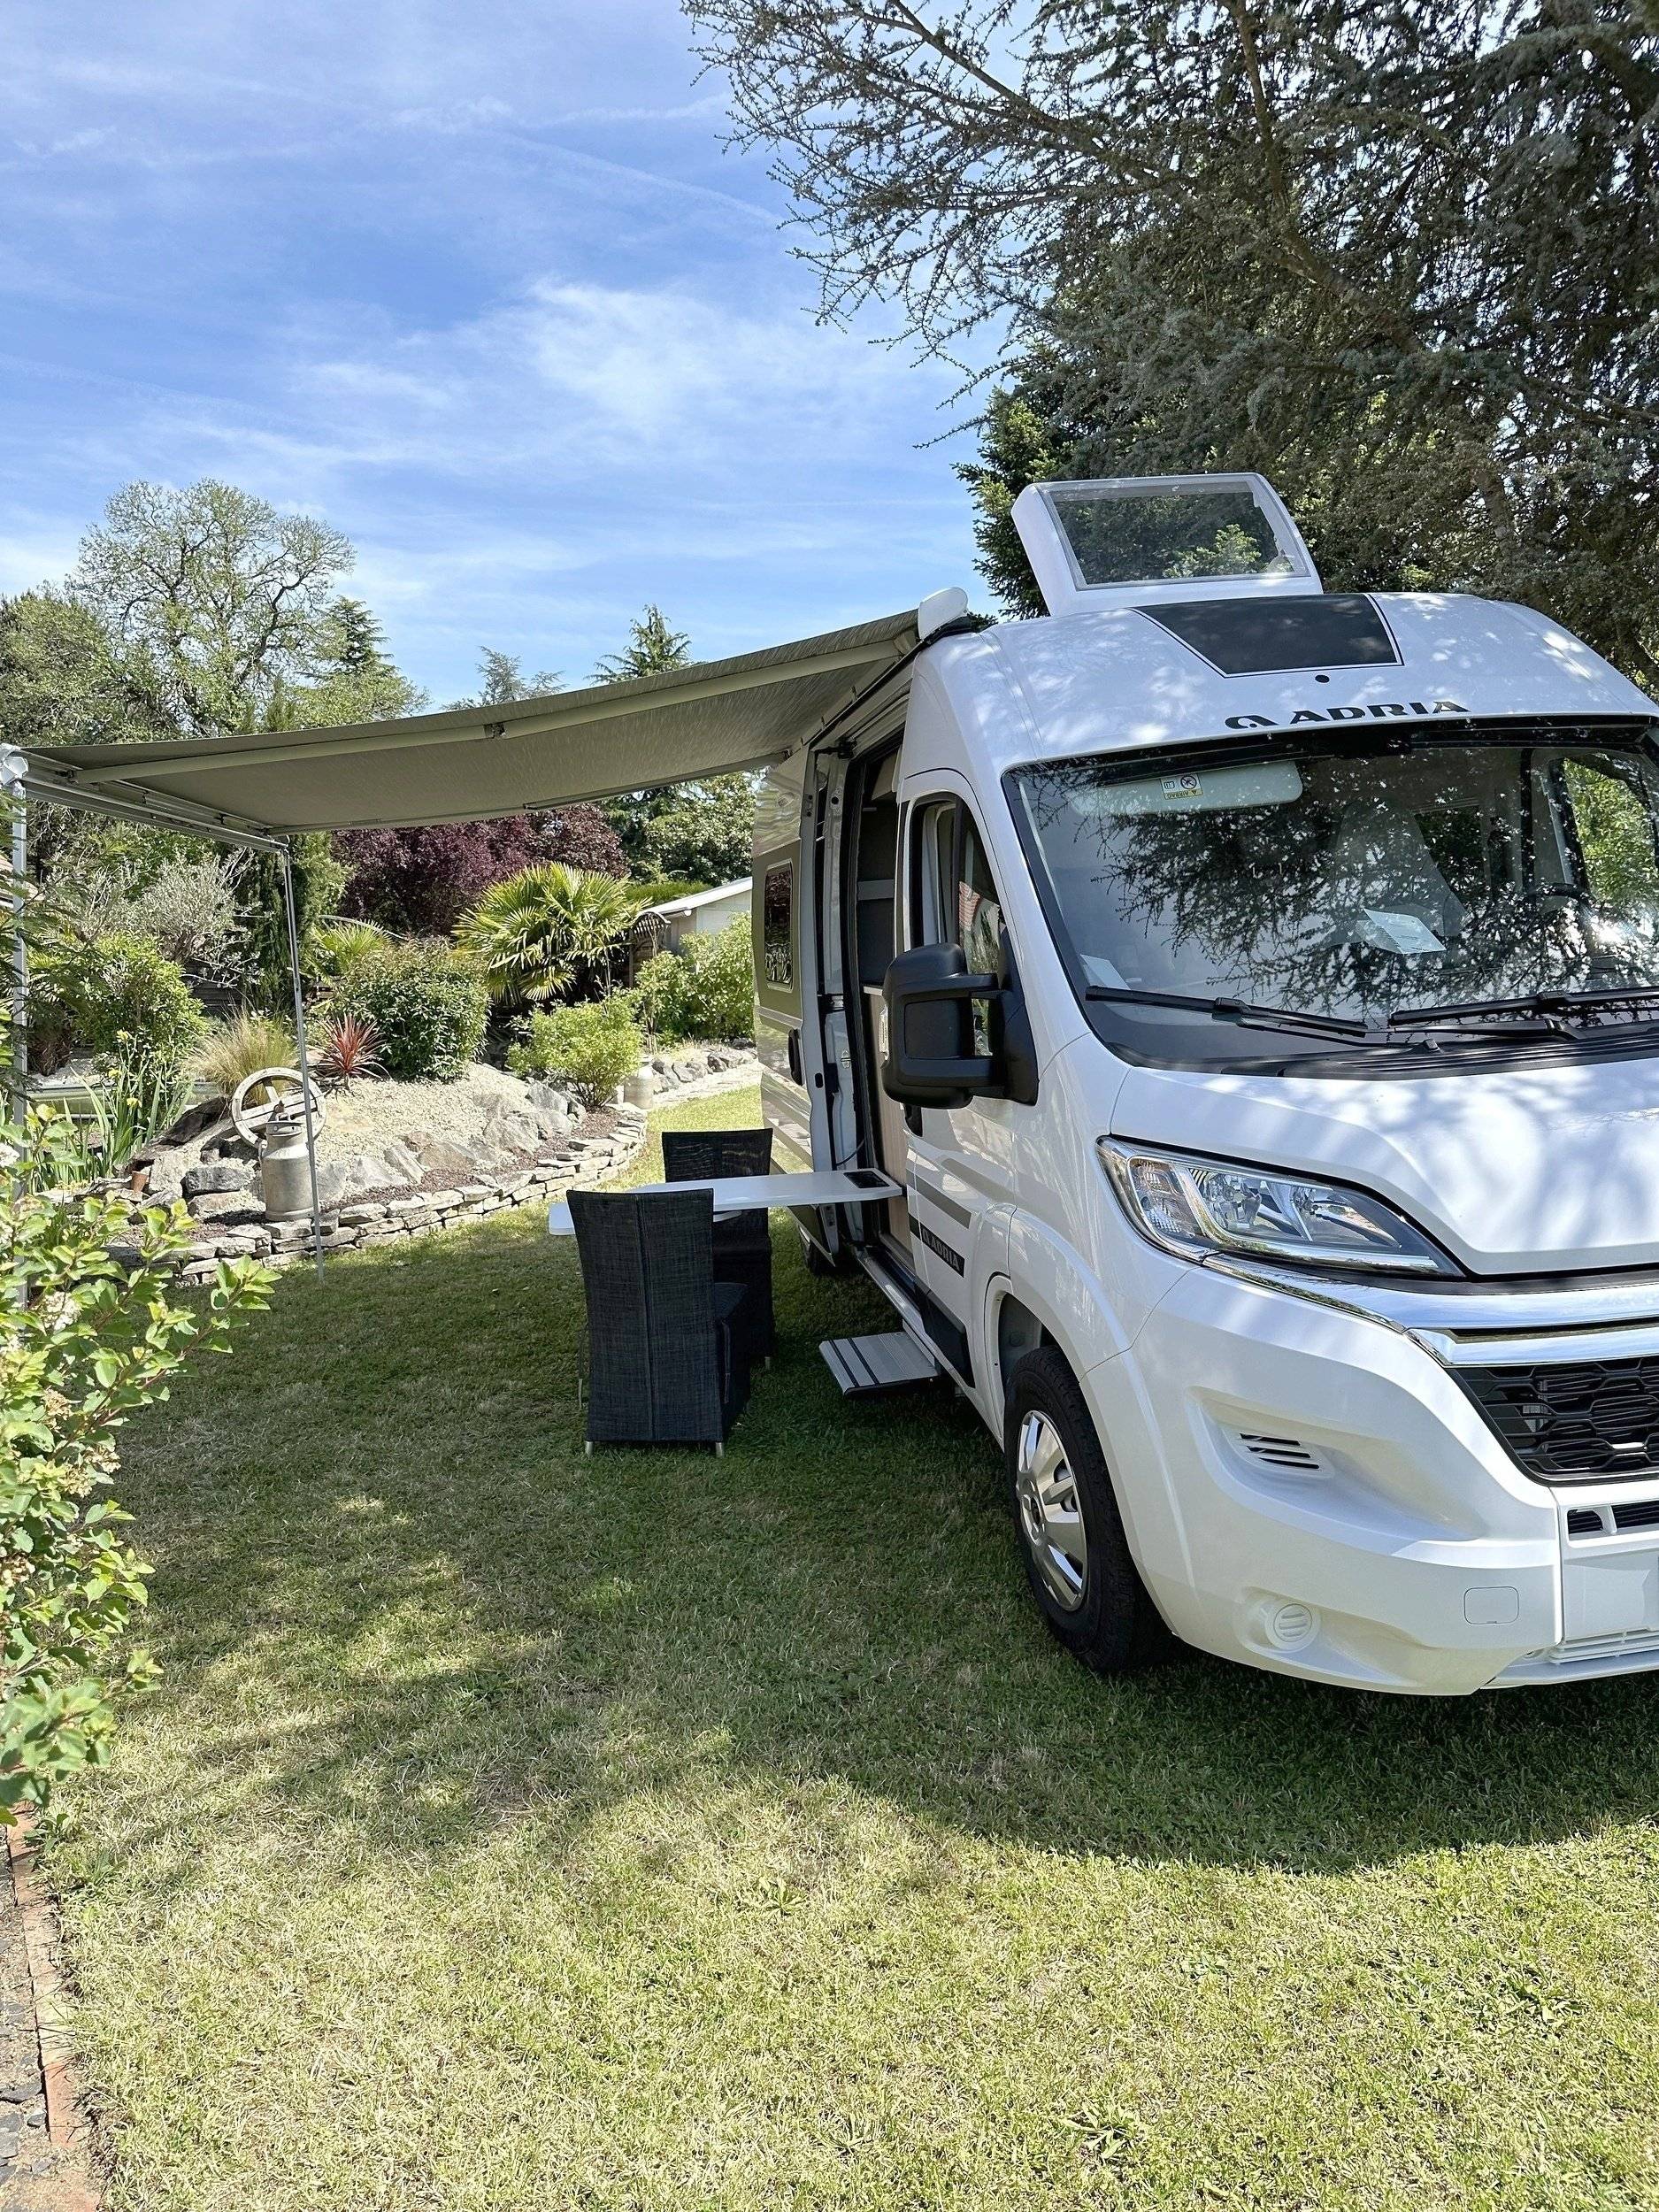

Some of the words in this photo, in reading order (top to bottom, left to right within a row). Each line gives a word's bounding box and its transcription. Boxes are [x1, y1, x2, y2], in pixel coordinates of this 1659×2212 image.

[1289, 701, 1472, 725] ADRIA
[1167, 790, 1189, 799] AIRBAG
[931, 1236, 960, 1271] ADRIA
